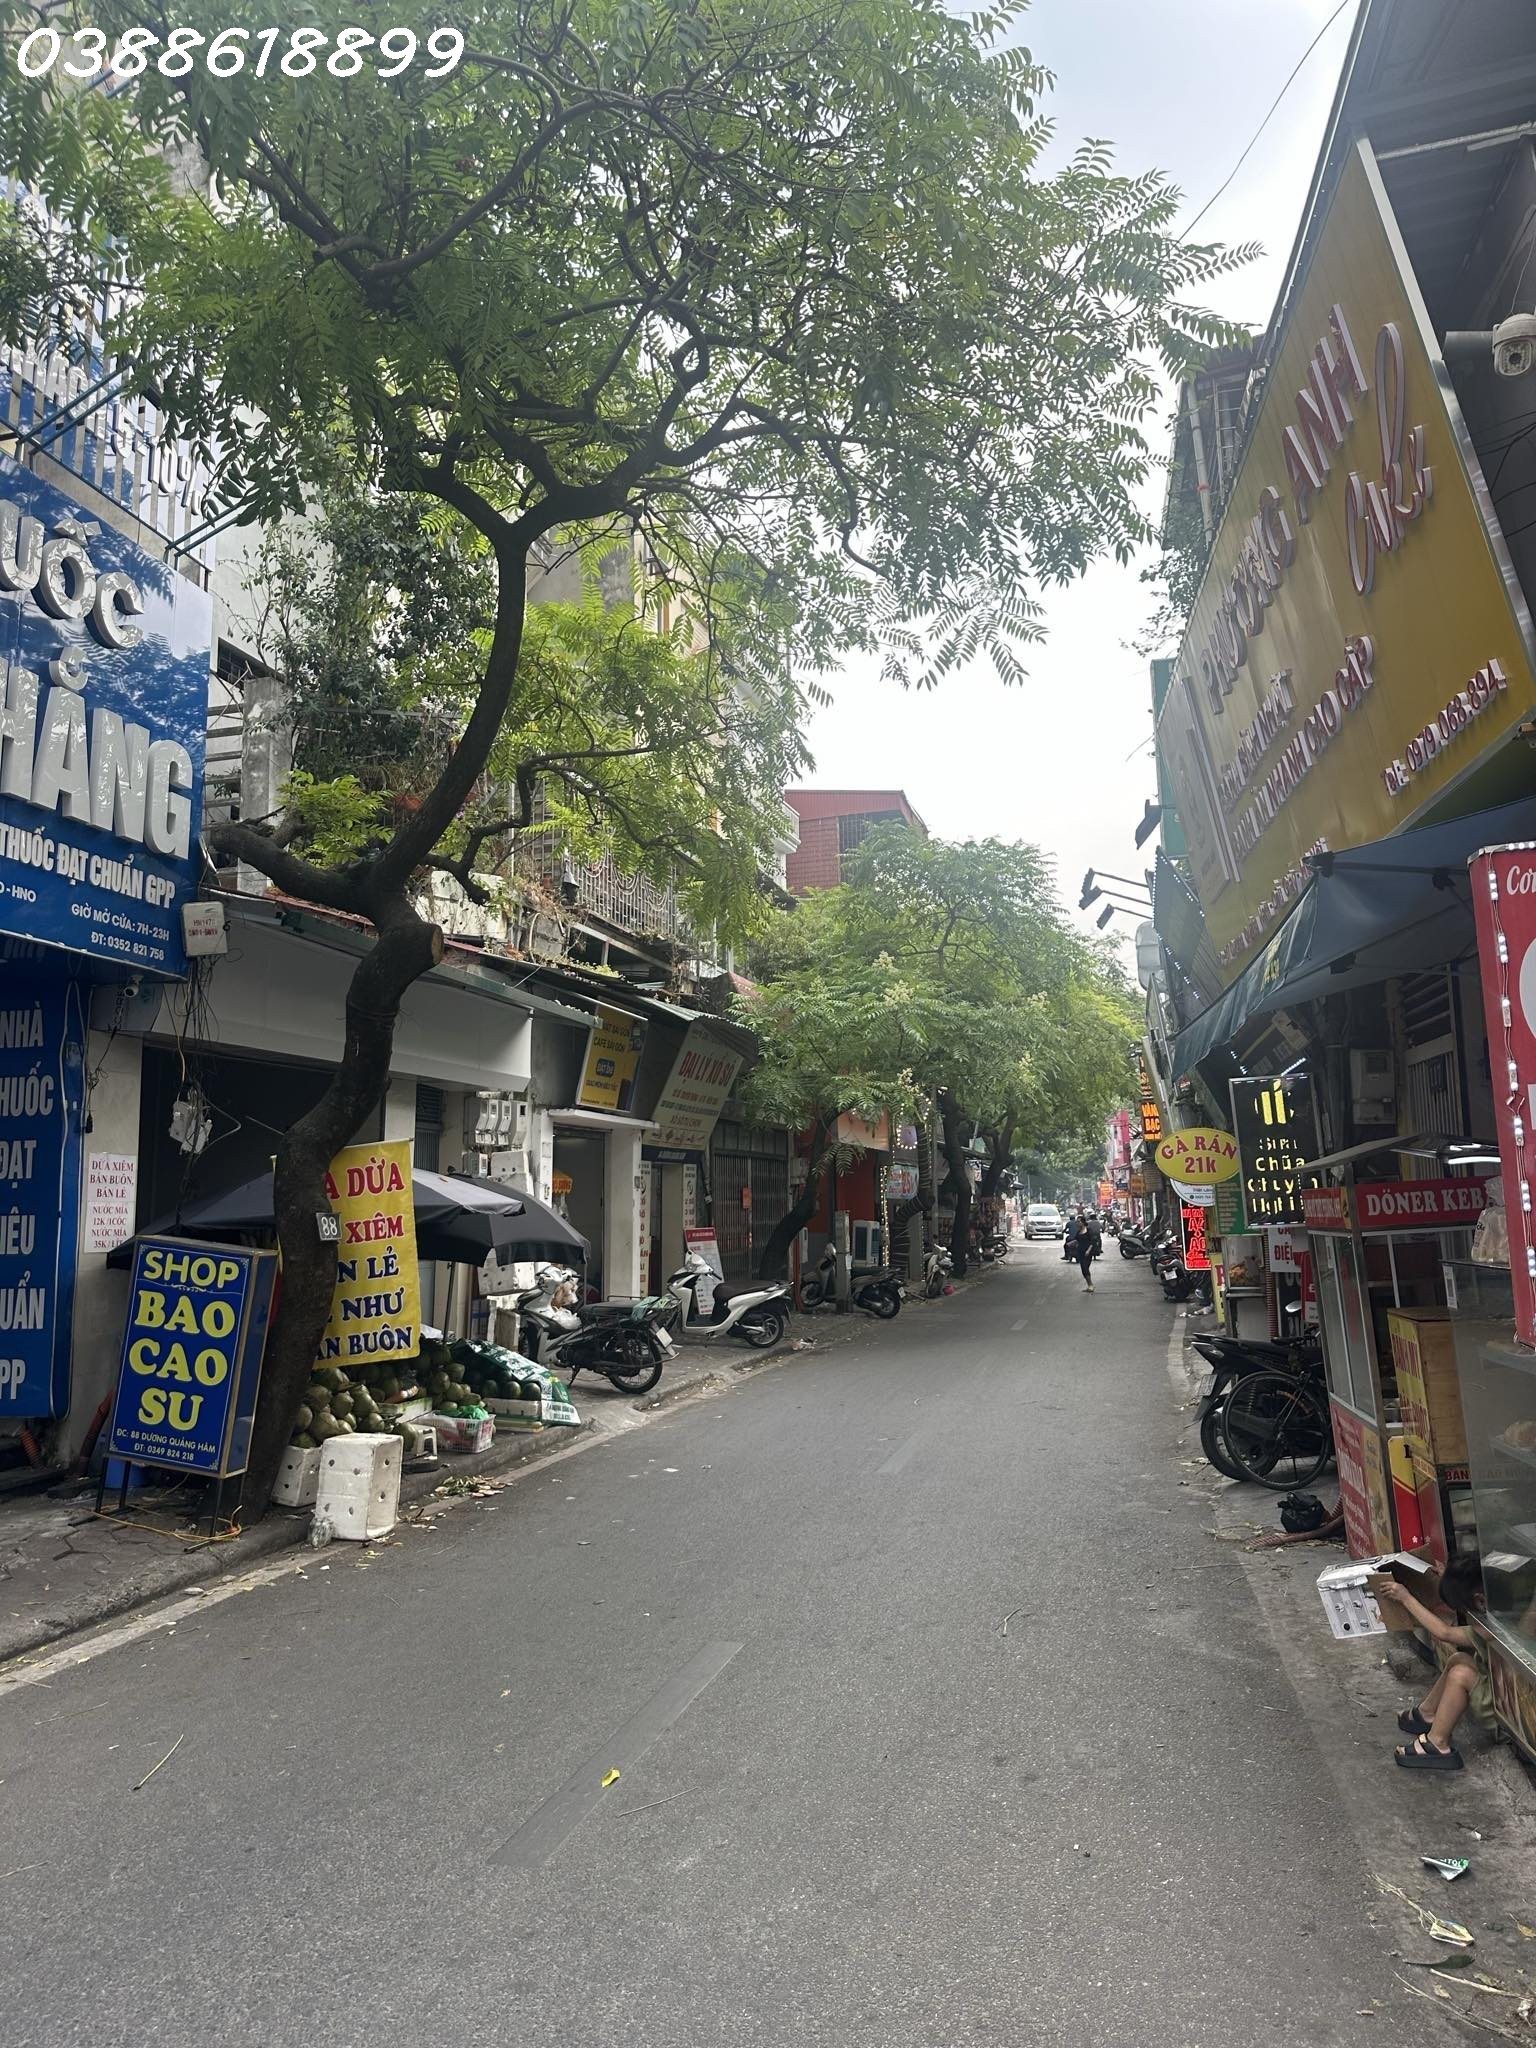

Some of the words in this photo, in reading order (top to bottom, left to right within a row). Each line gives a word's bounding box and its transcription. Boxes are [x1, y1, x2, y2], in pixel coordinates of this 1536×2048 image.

[56, 842, 89, 886] ĐẠT
[90, 853, 143, 900] CHUẨN
[145, 874, 176, 909] GPP
[71, 902, 92, 918] GIỜ
[93, 907, 110, 923] MỞ
[111, 913, 135, 931] CỬA:
[137, 922, 170, 941] 7H-23H
[90, 931, 107, 946] ĐT:
[107, 935, 131, 951] 0352
[133, 942, 147, 956] 821
[149, 946, 165, 961] 758
[0, 1001, 44, 1048] NHÀ
[1161, 1135, 1189, 1160] GÀ
[1194, 1134, 1238, 1160] RÁN
[347, 1156, 405, 1198] DỪA
[1366, 1190, 1438, 1216] DÖNER
[1442, 1187, 1492, 1211] KEB
[321, 1216, 337, 1237] 88
[345, 1212, 404, 1244] XIÊM
[143, 1250, 240, 1289] SHOP
[367, 1245, 400, 1280] LẺ
[134, 1289, 236, 1339] BAO
[341, 1287, 404, 1322] NHƯ
[348, 1323, 412, 1356] BUÔN
[129, 1338, 228, 1387] CAO
[138, 1387, 204, 1431] SU
